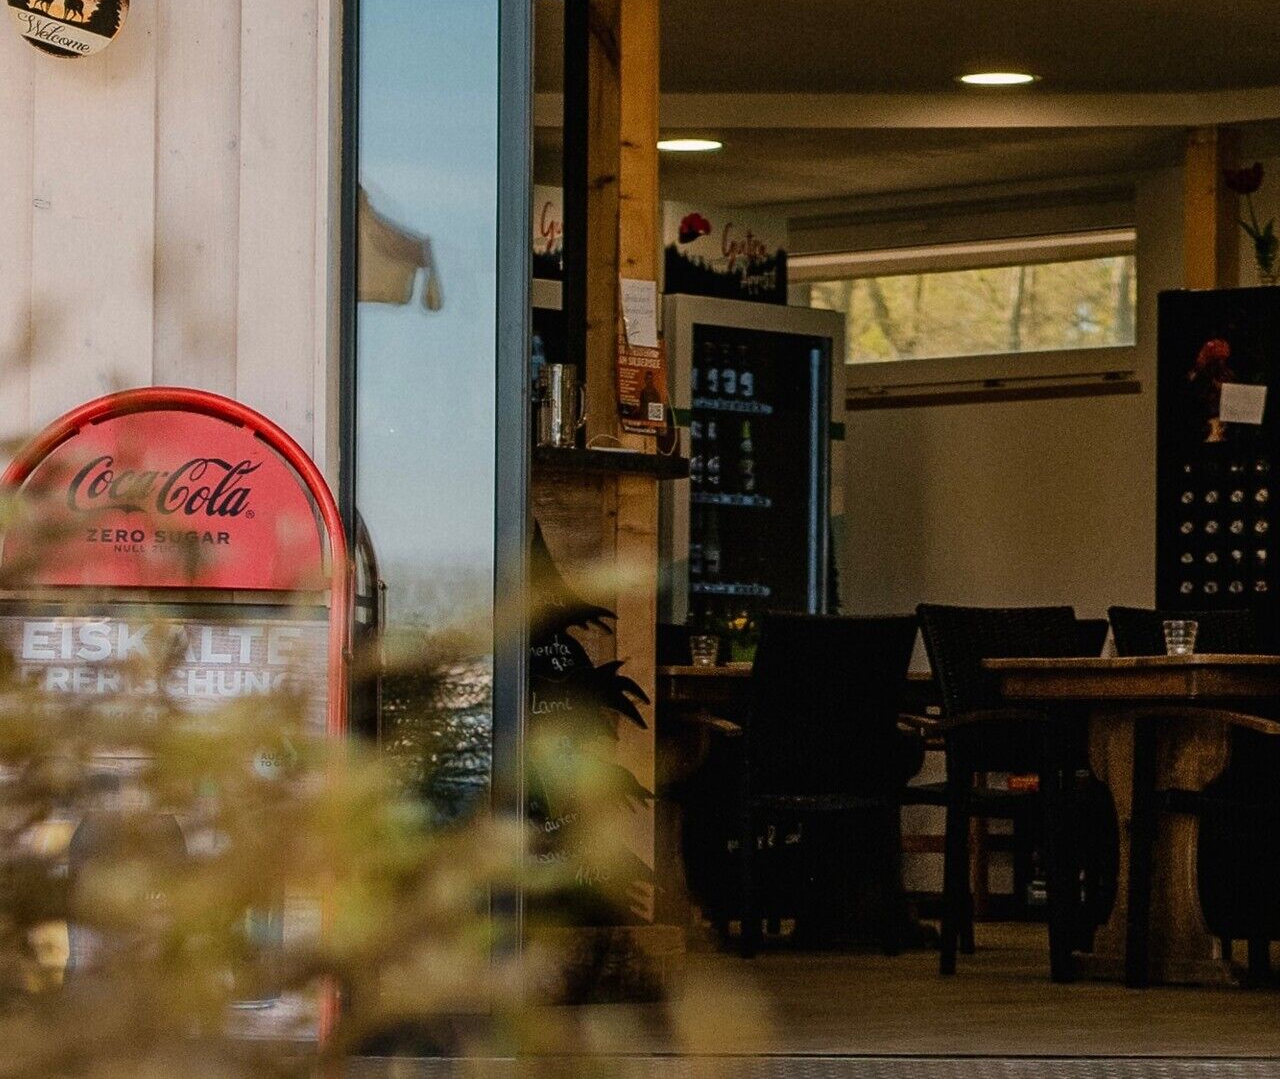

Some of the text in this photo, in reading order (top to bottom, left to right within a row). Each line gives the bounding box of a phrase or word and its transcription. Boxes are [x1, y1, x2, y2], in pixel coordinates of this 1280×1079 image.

[18, 12, 92, 55] Welcome
[67, 454, 262, 518] Coca-Cola
[87, 529, 231, 545] ZERO SUGAR
